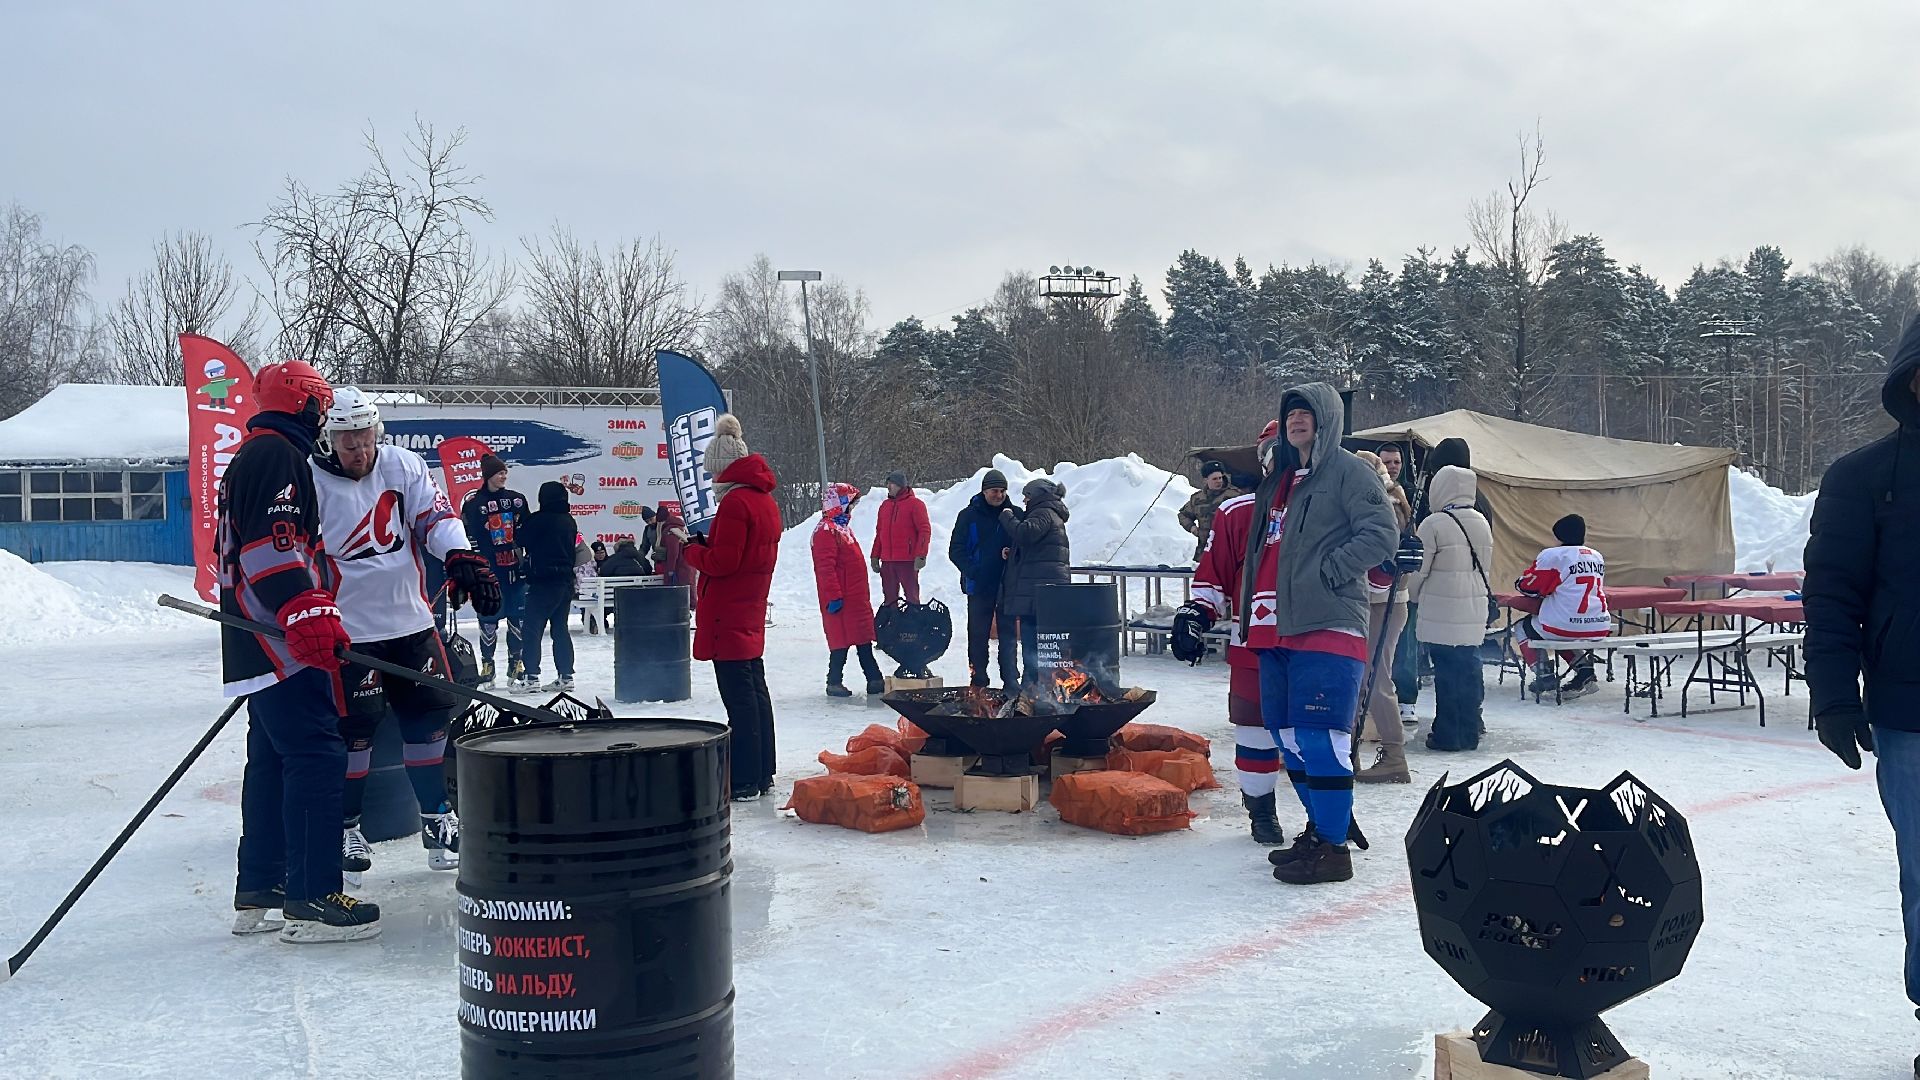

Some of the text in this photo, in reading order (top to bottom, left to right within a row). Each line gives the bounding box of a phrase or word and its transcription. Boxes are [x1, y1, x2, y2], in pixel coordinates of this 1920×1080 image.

[608, 419, 646, 429] ЗИМА
[599, 477, 638, 486] ЗИМА
[479, 899, 573, 921] ЗАПОМНИ:
[494, 935, 590, 959] ХОККЕИСТ,
[495, 973, 516, 995] НА
[521, 973, 577, 999] ЛЬДУ,
[488, 1008, 597, 1033] СОПЕРНИКИ
